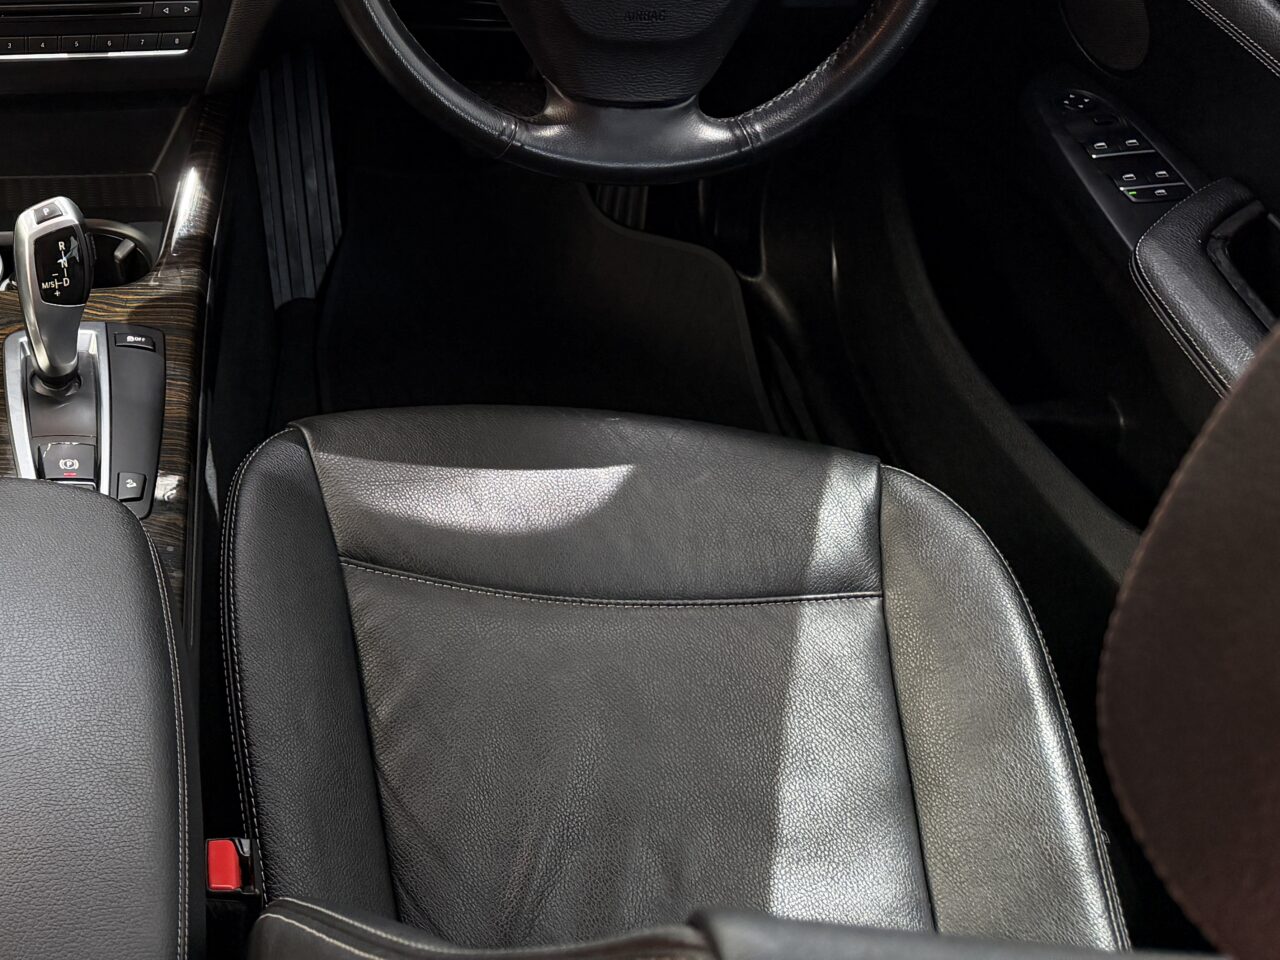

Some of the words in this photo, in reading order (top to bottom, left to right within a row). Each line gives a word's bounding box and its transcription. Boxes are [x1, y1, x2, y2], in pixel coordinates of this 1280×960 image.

[42, 207, 49, 215] P
[58, 241, 65, 251] R
[41, 281, 55, 289] M/S
[63, 277, 70, 287] D
